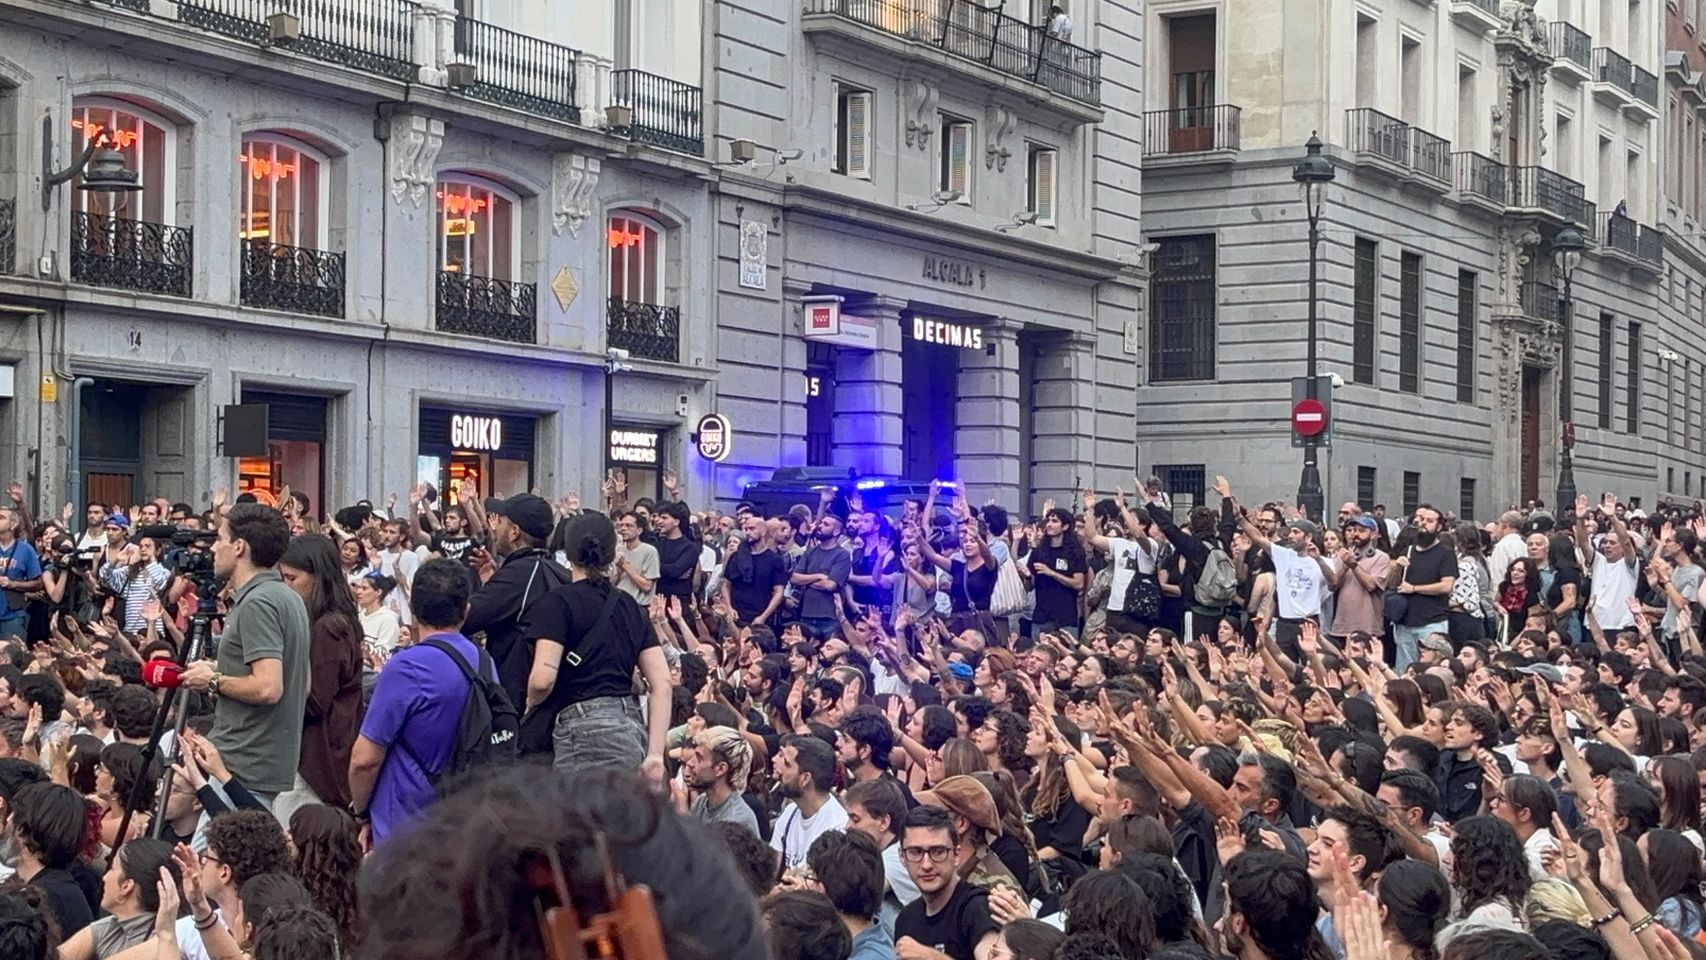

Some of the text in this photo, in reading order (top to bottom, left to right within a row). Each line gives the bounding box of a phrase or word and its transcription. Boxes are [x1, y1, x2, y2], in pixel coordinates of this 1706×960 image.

[130, 331, 141, 347] 14
[913, 317, 982, 349] DECIMAS
[451, 415, 501, 450] GOIKO
[610, 430, 658, 447] OURMET
[610, 446, 657, 462] URGERS
